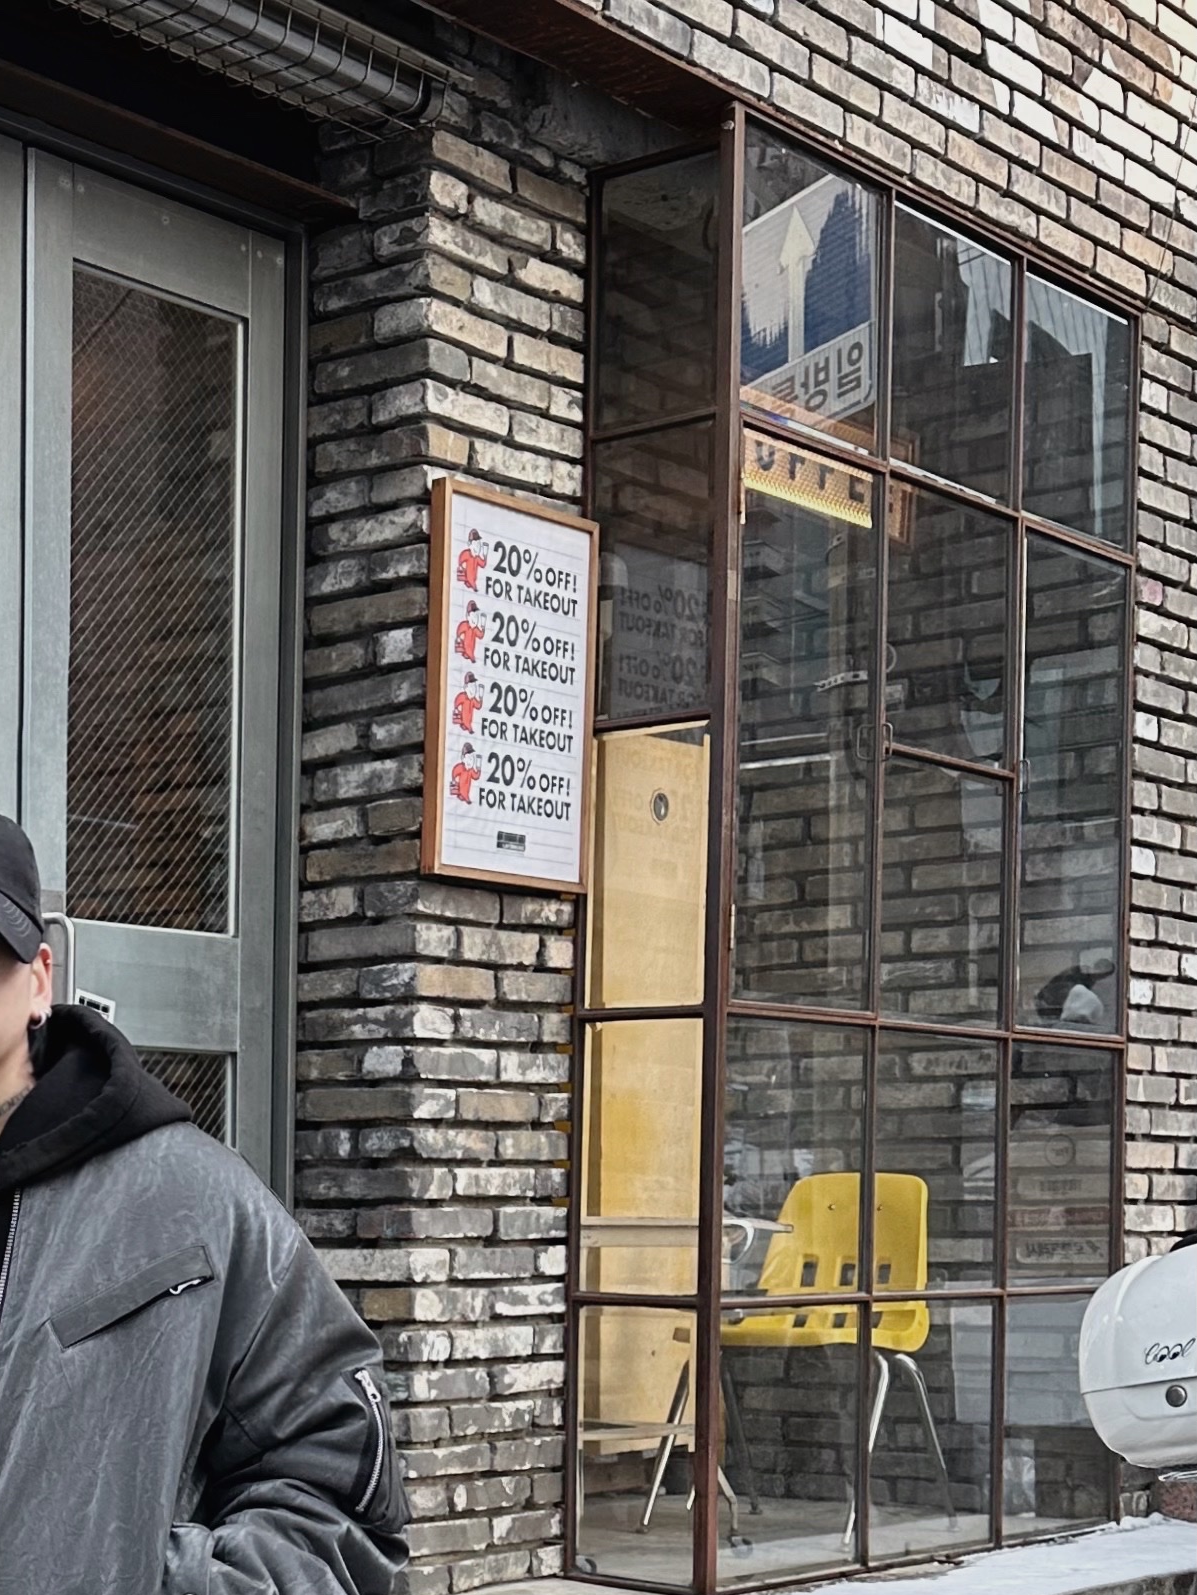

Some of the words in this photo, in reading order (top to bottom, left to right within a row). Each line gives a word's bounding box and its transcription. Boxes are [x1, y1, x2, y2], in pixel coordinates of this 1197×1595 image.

[493, 541, 543, 583] 20%
[545, 567, 577, 593] OFF!
[485, 576, 513, 601] FOR
[517, 584, 578, 617] TAKEOUT
[491, 611, 541, 651] 20%
[543, 636, 575, 661] OFF!
[484, 647, 510, 671] FOR
[515, 655, 576, 685] TAKEOUT
[489, 682, 538, 721] 20%
[541, 705, 573, 729] OFF!
[481, 718, 508, 741] FOR
[513, 724, 574, 753] TAKEOUT
[486, 752, 536, 790] 20%
[539, 773, 571, 797] OFF!
[479, 788, 506, 810] FOR
[510, 793, 571, 821] TAKEOUT
